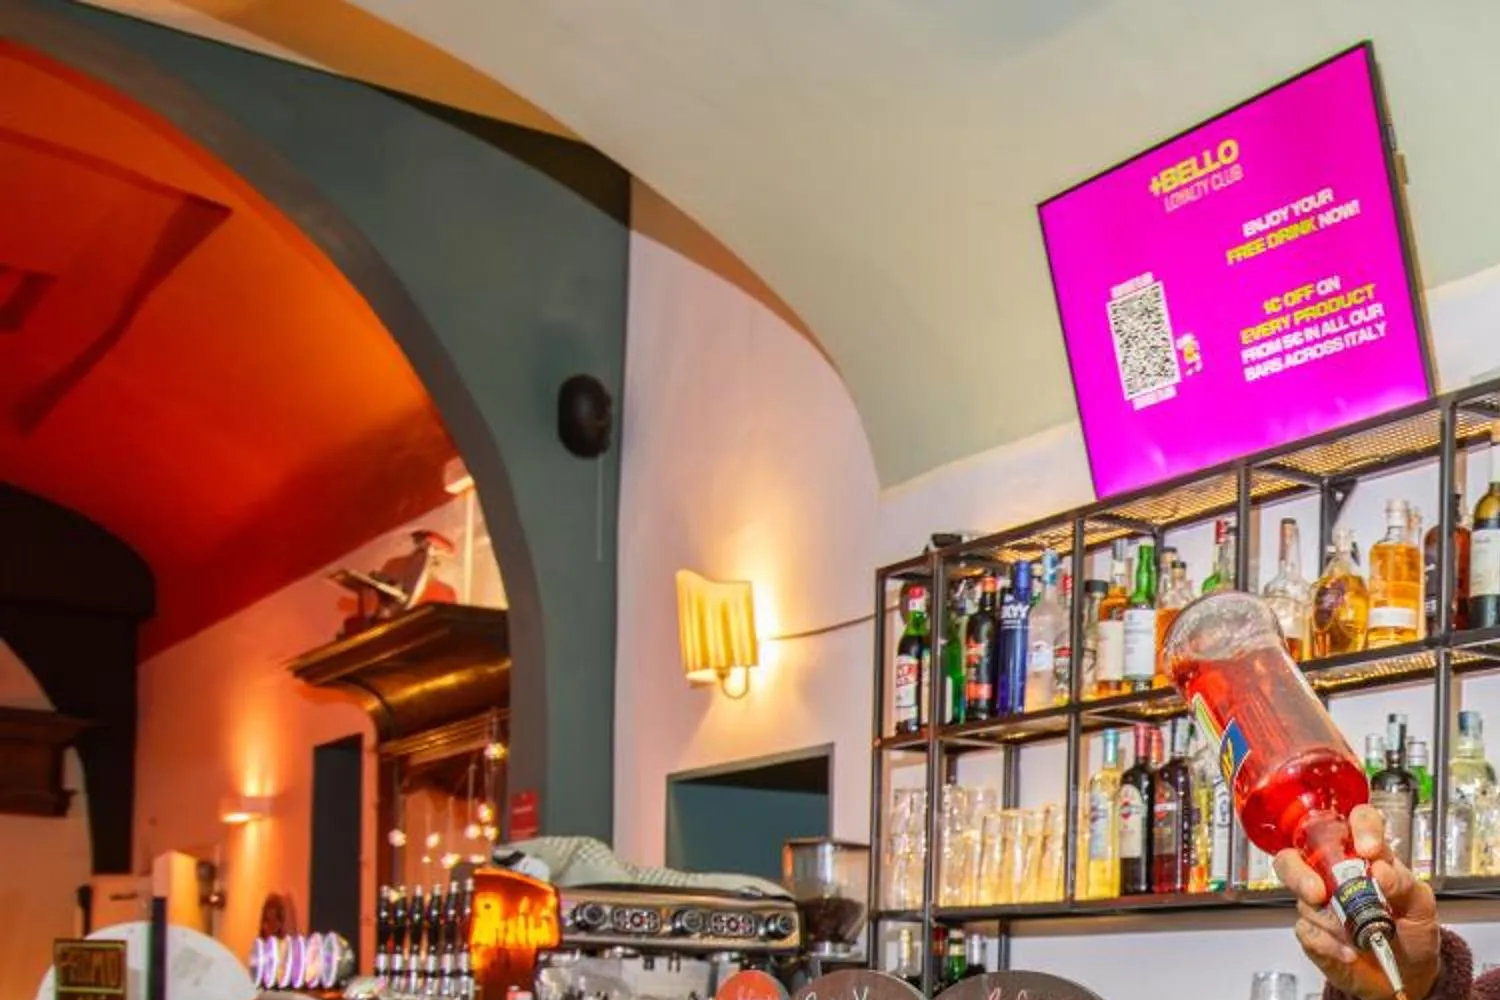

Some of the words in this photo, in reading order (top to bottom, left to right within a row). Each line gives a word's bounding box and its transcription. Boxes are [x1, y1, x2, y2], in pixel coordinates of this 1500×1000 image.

[1212, 164, 1244, 192] CLUB
[1226, 237, 1266, 266] FREE
[1267, 217, 1318, 250] DRINK
[1318, 199, 1360, 228] NOW!
[1242, 207, 1289, 238] ENJOY
[1290, 187, 1335, 215] YOUR
[1240, 315, 1290, 345] EVERY
[1294, 283, 1376, 325] PRODUCT
[1284, 284, 1314, 307] OFF
[1316, 275, 1341, 296] ON
[1241, 338, 1282, 365] FROM
[1304, 324, 1320, 342] IN
[1321, 315, 1349, 337] ALL
[1349, 302, 1385, 325] OUR
[1243, 358, 1284, 383] BARS
[1284, 337, 1344, 367] ACROSS
[1344, 321, 1387, 348] ITALY
